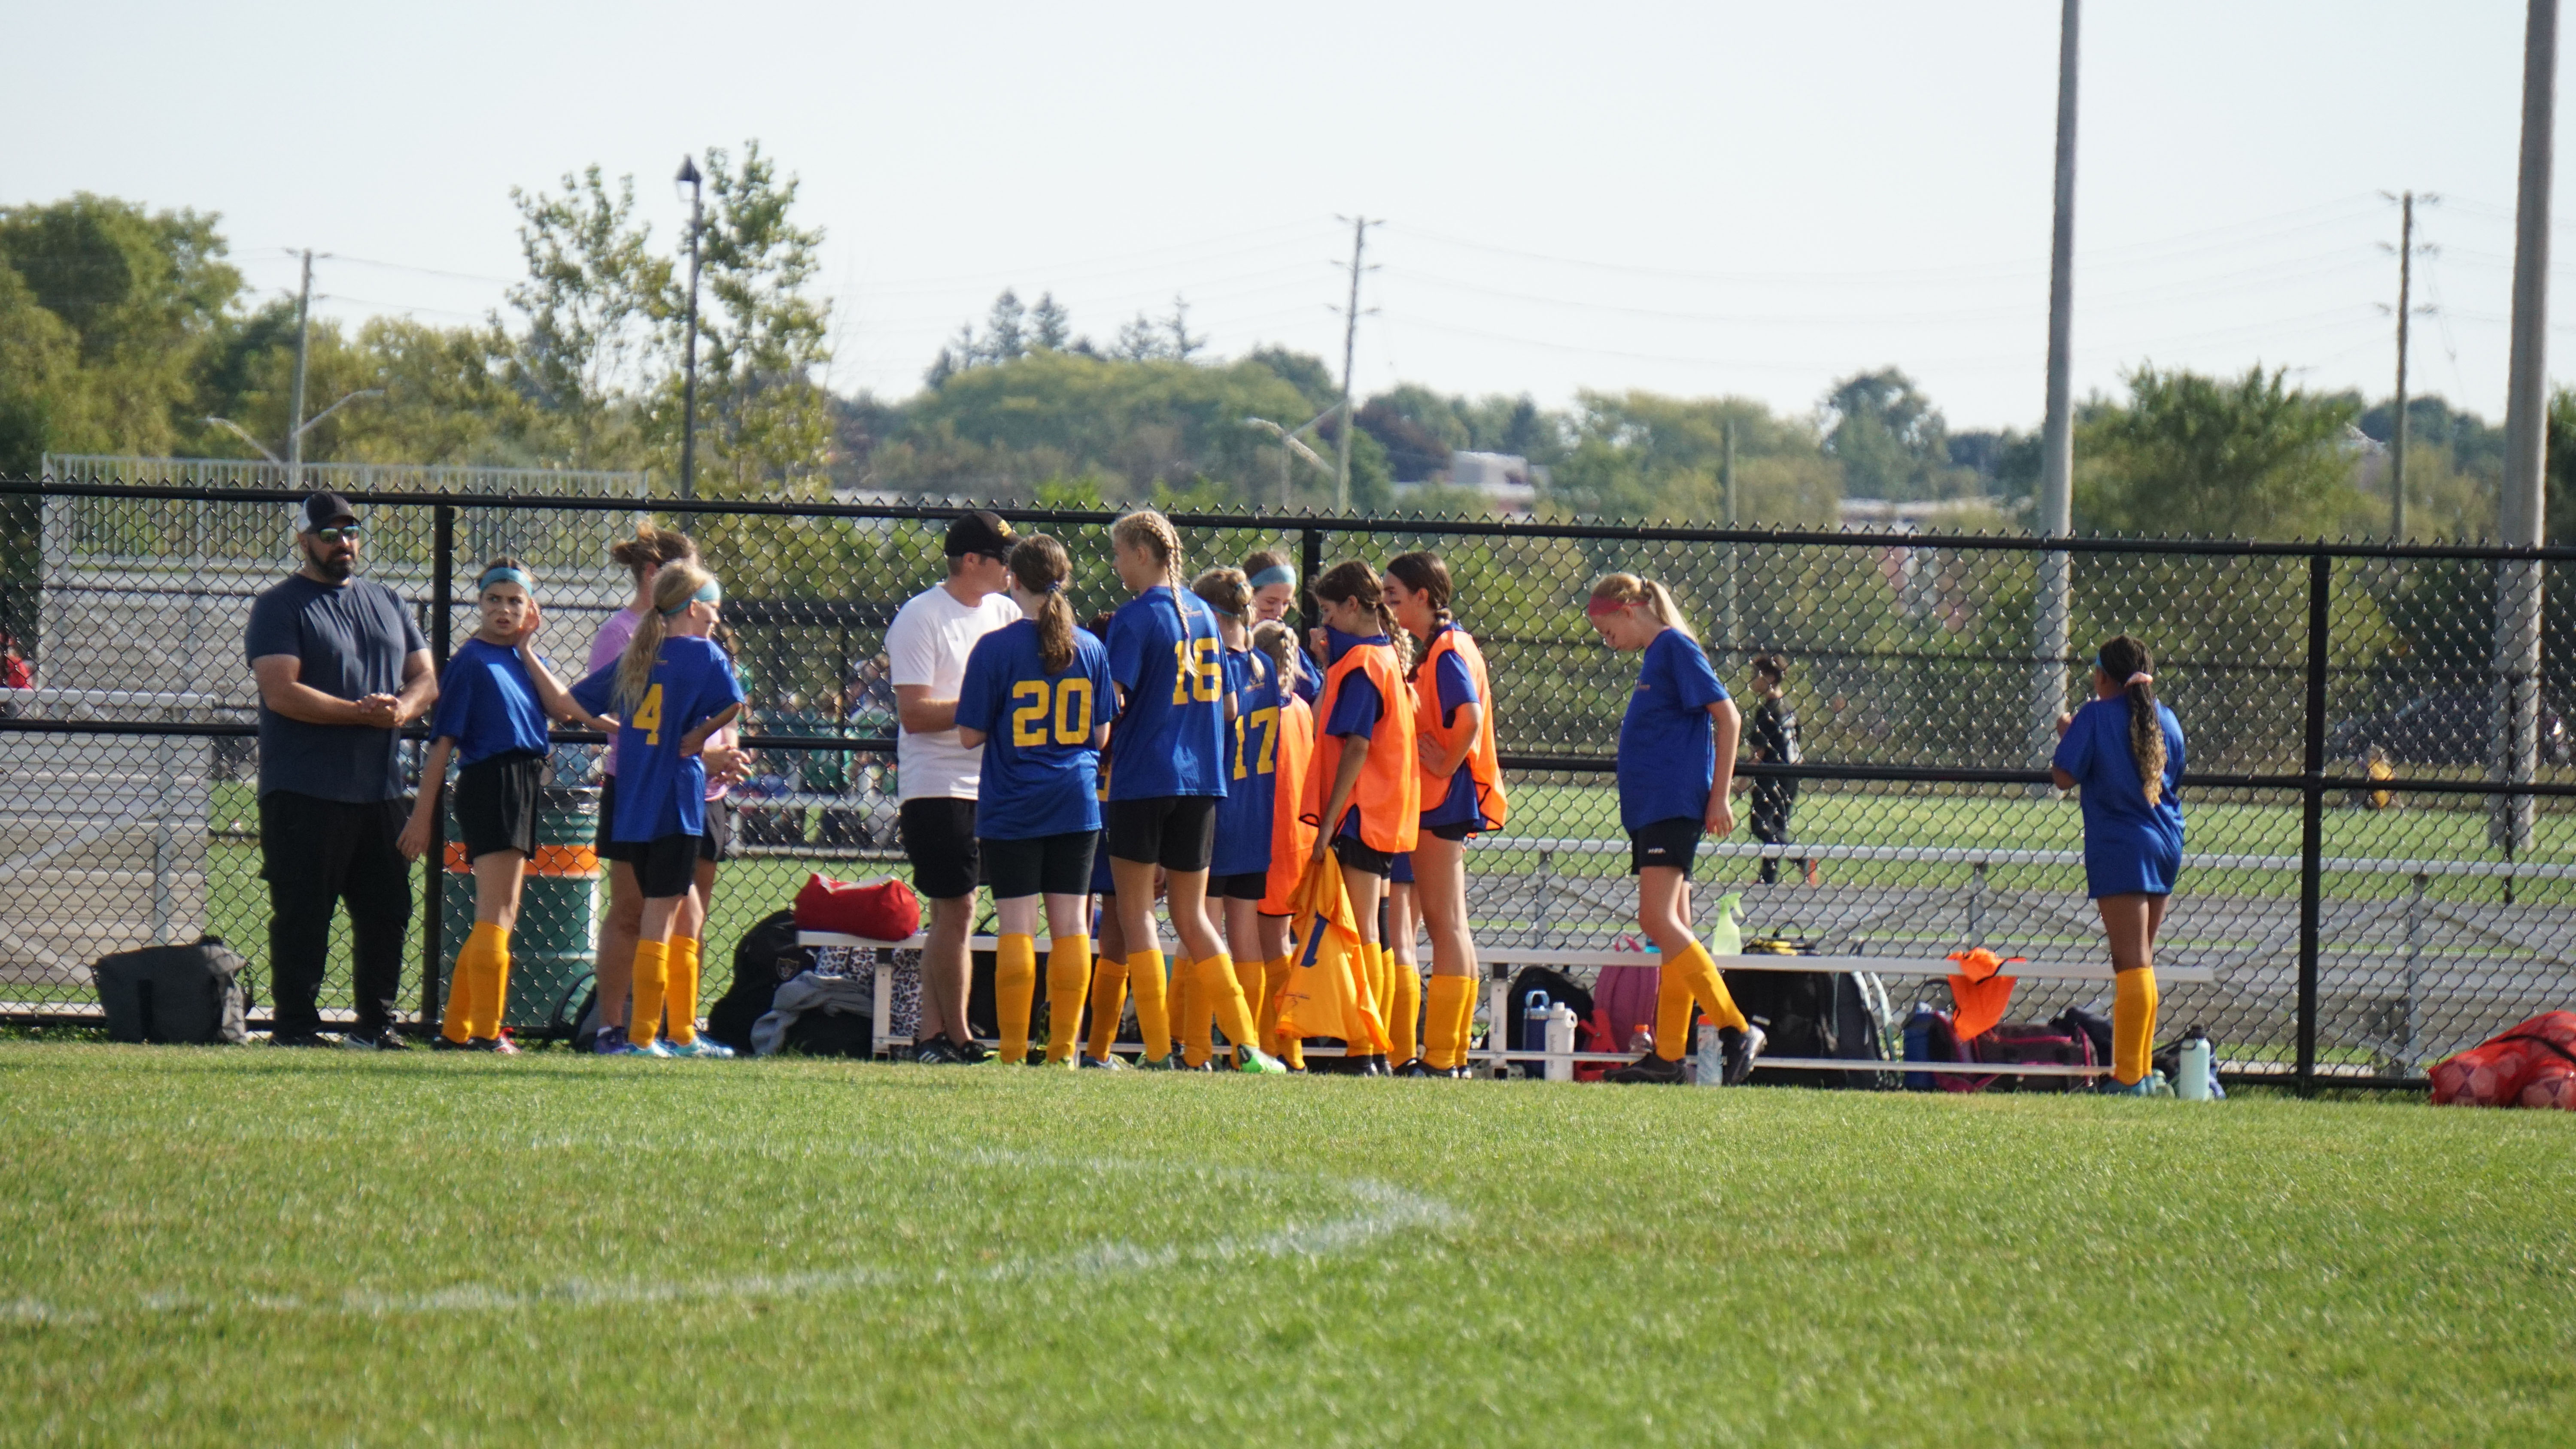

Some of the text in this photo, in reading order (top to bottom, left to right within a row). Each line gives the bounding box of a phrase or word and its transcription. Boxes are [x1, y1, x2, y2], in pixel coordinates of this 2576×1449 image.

[1173, 637, 1222, 705] 16
[632, 683, 663, 745] 4
[1012, 677, 1092, 747] 20
[1233, 706, 1280, 780] 17
